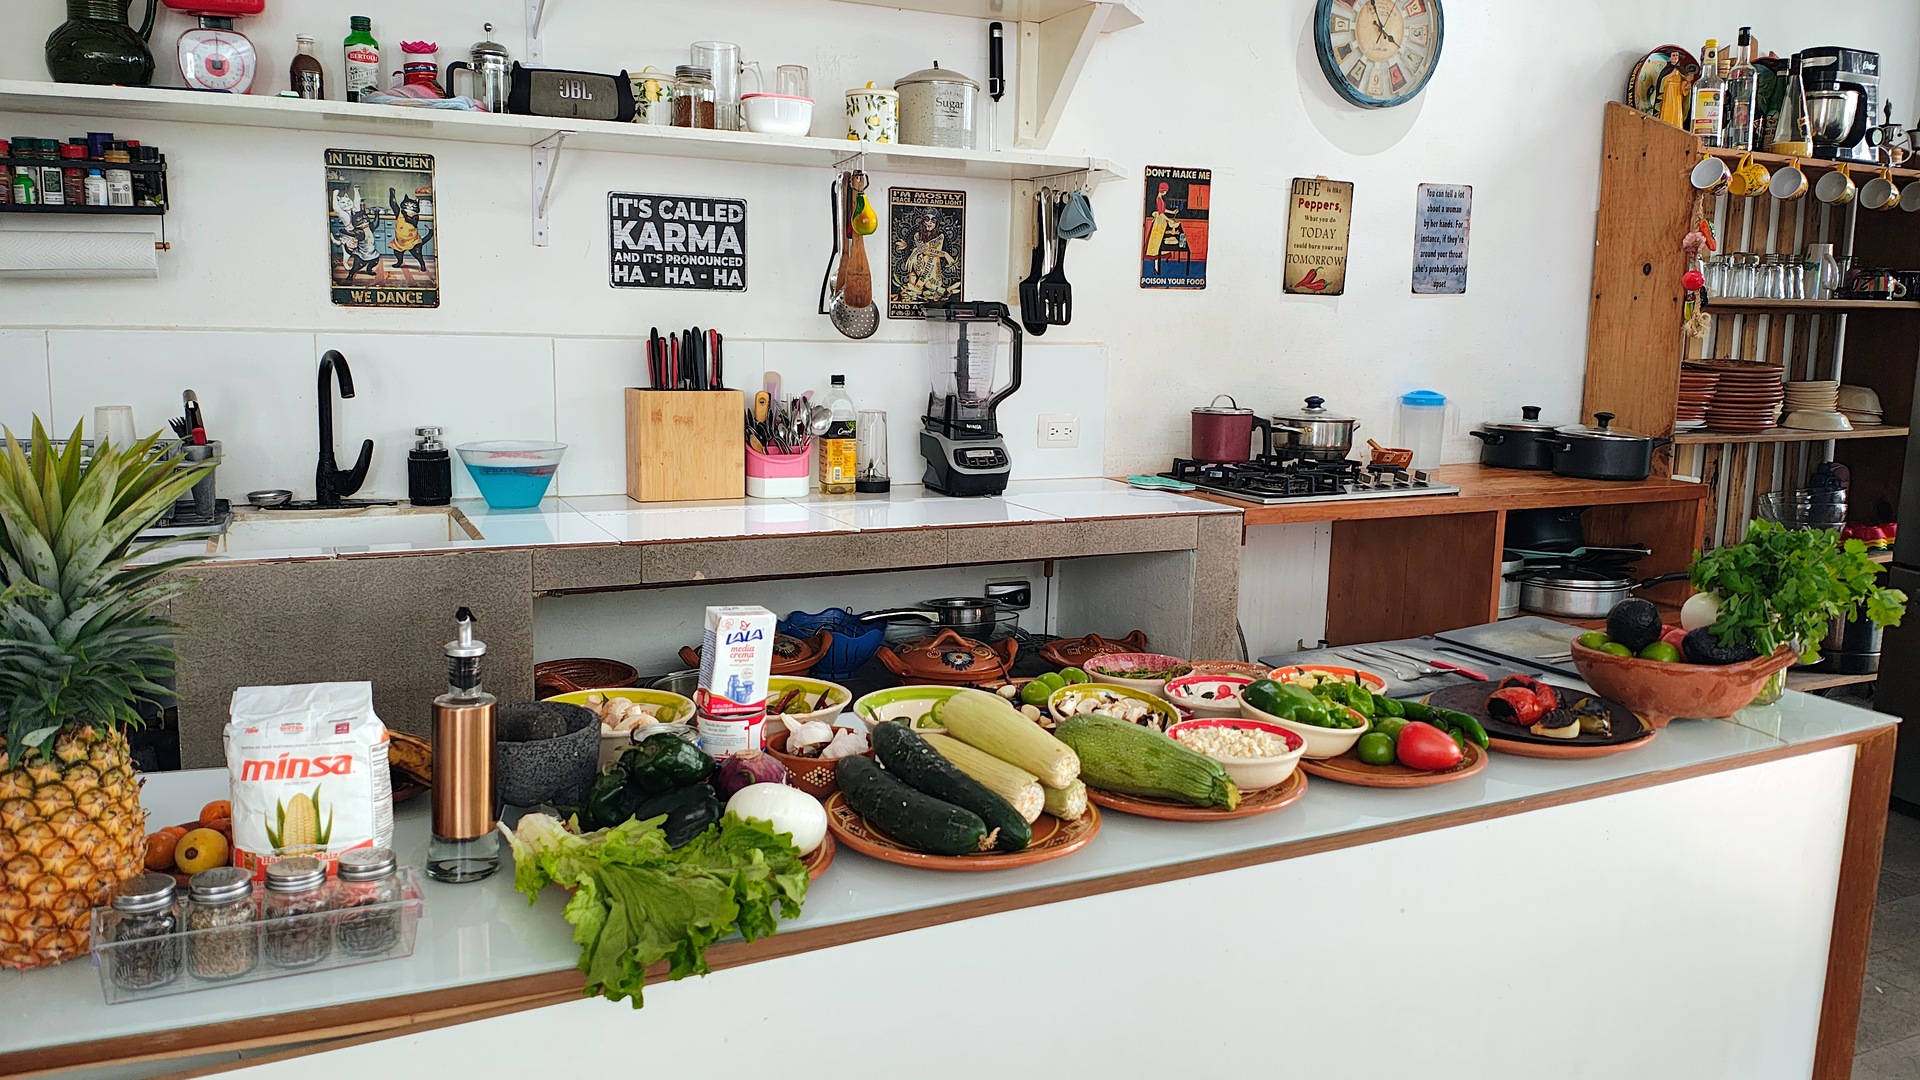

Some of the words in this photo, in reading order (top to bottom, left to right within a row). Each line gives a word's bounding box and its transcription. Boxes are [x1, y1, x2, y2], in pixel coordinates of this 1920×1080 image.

[560, 80, 592, 100] JBL
[936, 97, 964, 110] Sugar
[329, 153, 342, 164] IN
[347, 154, 373, 165] THIS
[378, 156, 430, 169] KITCHEN
[1146, 167, 1171, 178] DON'T
[1172, 170, 1196, 179] MAKE
[1198, 171, 1210, 179] ME
[1294, 180, 1320, 196] LIFE
[1445, 190, 1453, 198] tell
[612, 198, 652, 218] IT'S
[658, 200, 744, 223] CALLED
[1298, 198, 1342, 213] Peppers,
[1424, 220, 1429, 229] by
[1440, 220, 1454, 228] hands.
[1455, 220, 1463, 228] For
[613, 220, 742, 254] KARMA
[1300, 227, 1336, 239] TODAY
[1421, 234, 1441, 245] instance,
[1442, 235, 1446, 243] if
[1447, 234, 1464, 246] they're
[615, 252, 640, 262] AND
[643, 254, 663, 263] IT'S
[666, 255, 743, 267] PRONOUNCED
[1288, 254, 1344, 266] TOMORROW
[1420, 250, 1436, 258] around
[1437, 252, 1448, 260] your
[1449, 250, 1463, 258] throat
[614, 265, 645, 282] HA
[665, 266, 695, 284] HA
[713, 269, 743, 286] HA
[1415, 264, 1428, 272] she's
[1428, 264, 1449, 275] probably
[1433, 281, 1446, 290] upset
[351, 291, 373, 303] WE
[377, 292, 423, 304] DANCE
[726, 629, 763, 645] LALA
[730, 644, 755, 652] media
